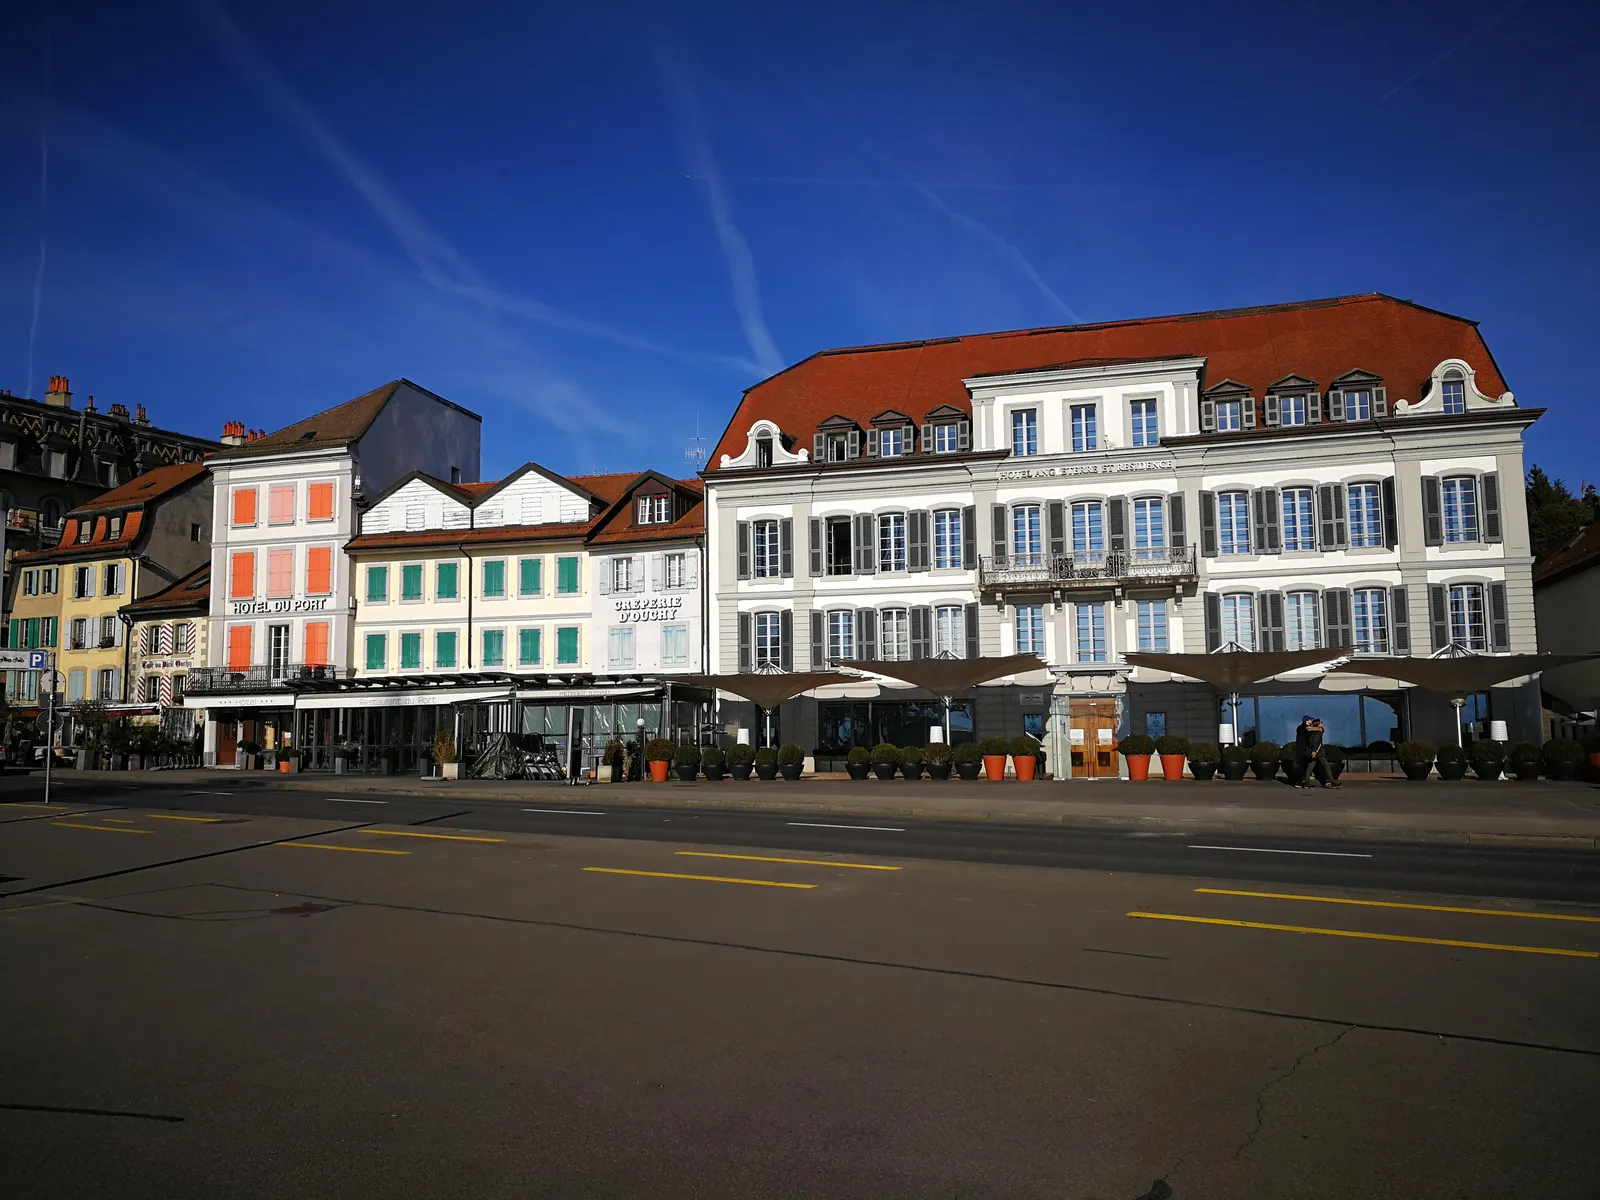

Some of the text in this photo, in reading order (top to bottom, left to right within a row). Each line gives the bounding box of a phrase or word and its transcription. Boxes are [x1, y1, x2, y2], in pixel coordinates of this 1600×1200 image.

[999, 469, 1033, 480] HOTEL
[1101, 464, 1114, 473] ET
[1116, 460, 1173, 472] RESIDENCE
[233, 598, 327, 614] HOTEL DU PORT
[614, 597, 681, 611] CREPERIE
[619, 609, 677, 623] D'OUCHY
[32, 654, 41, 666] P
[359, 696, 437, 706] Restaurant du Port
